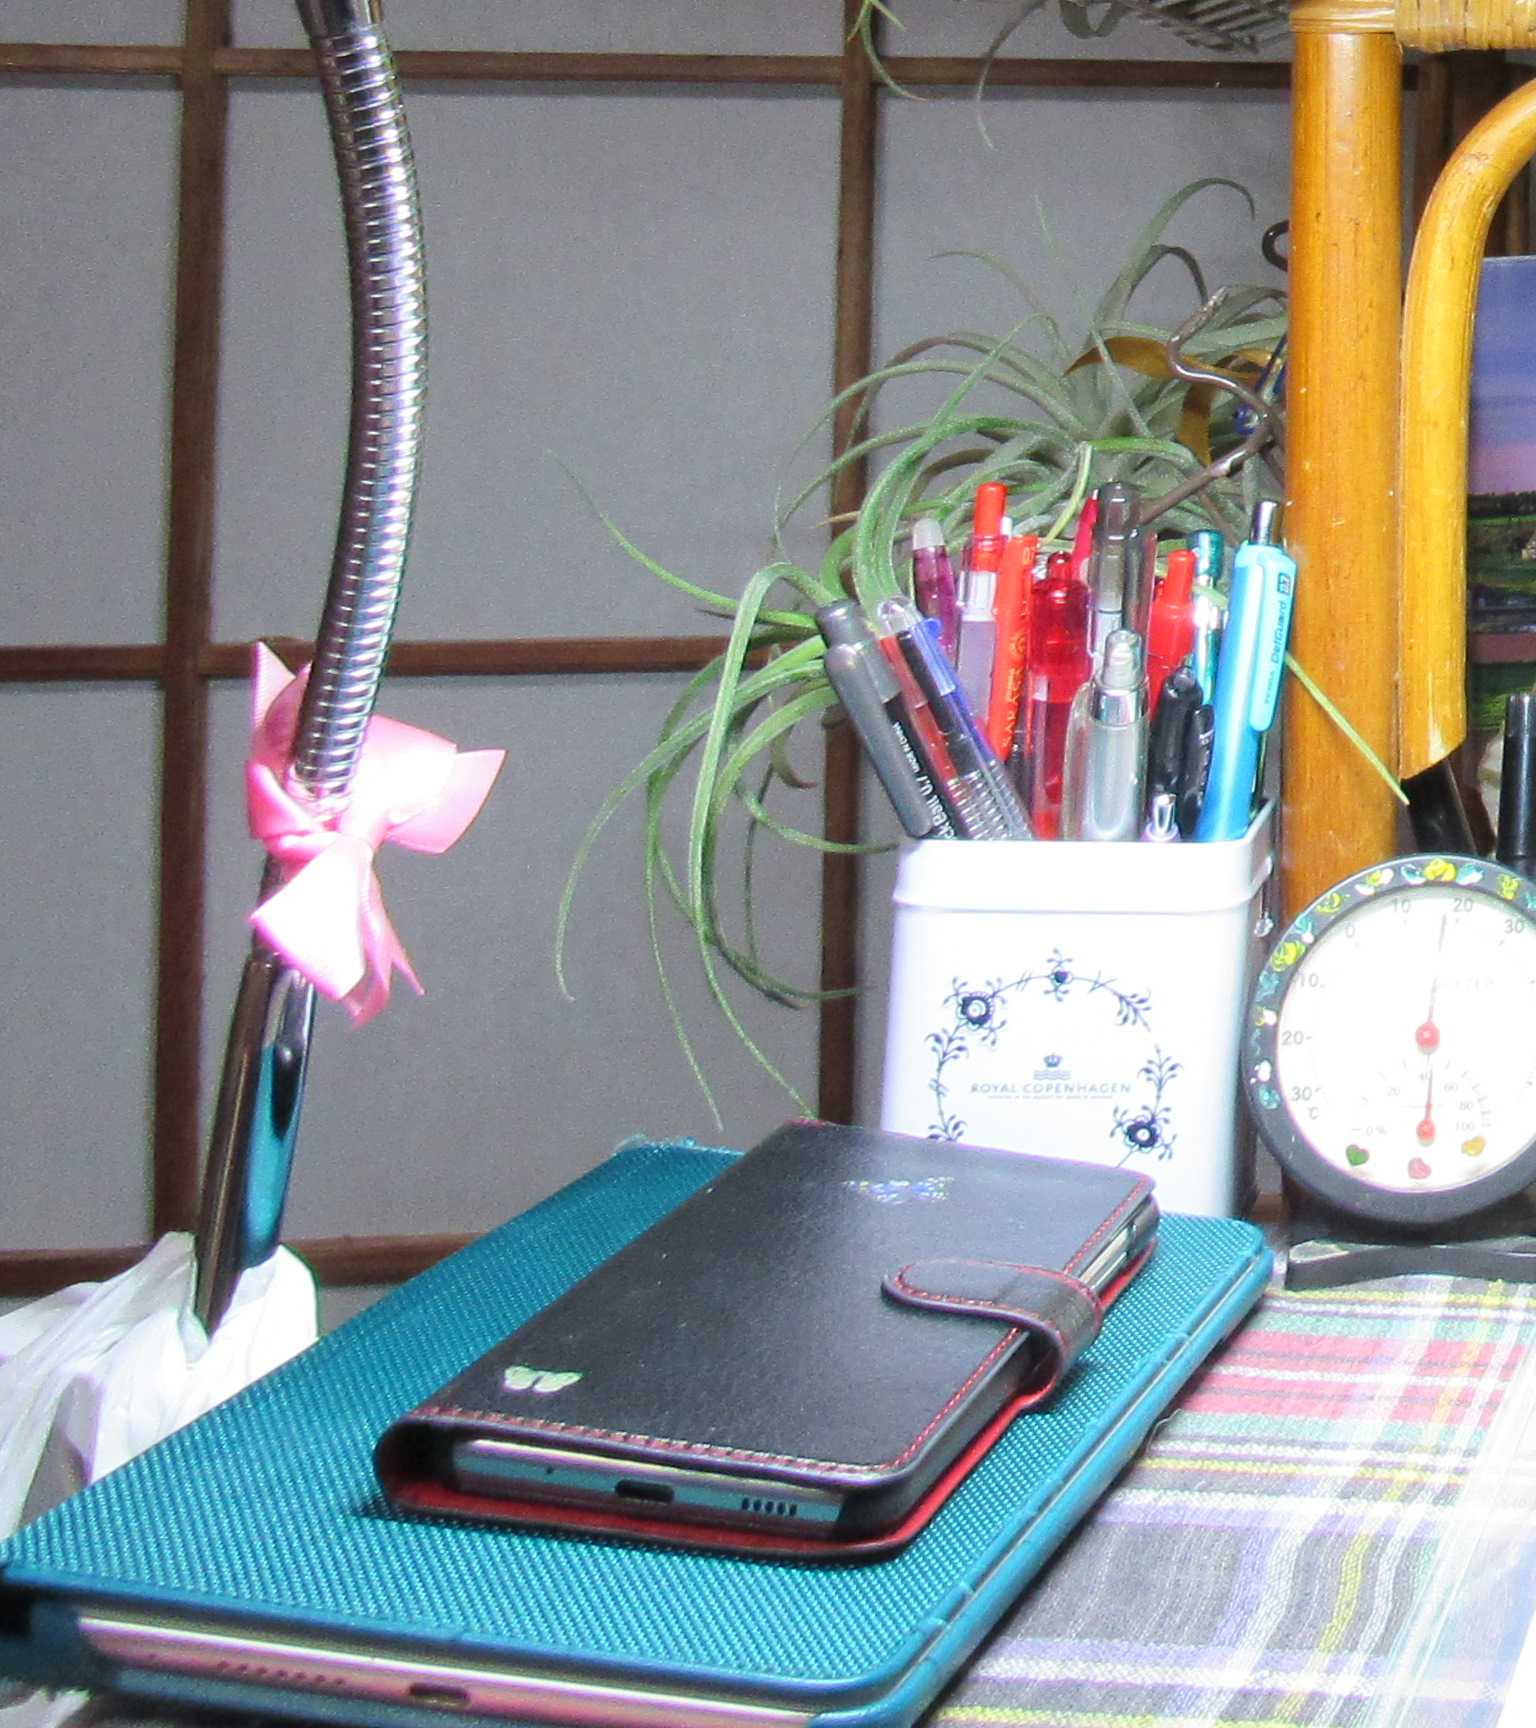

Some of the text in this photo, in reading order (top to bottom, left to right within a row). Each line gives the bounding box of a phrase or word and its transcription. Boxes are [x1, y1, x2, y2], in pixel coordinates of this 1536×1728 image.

[1391, 897, 1412, 913] 10
[1453, 896, 1475, 913] 20
[1345, 924, 1357, 940] 0
[1504, 918, 1526, 934] 30
[970, 1082, 1132, 1094] ROYAL COPENHAGEN
